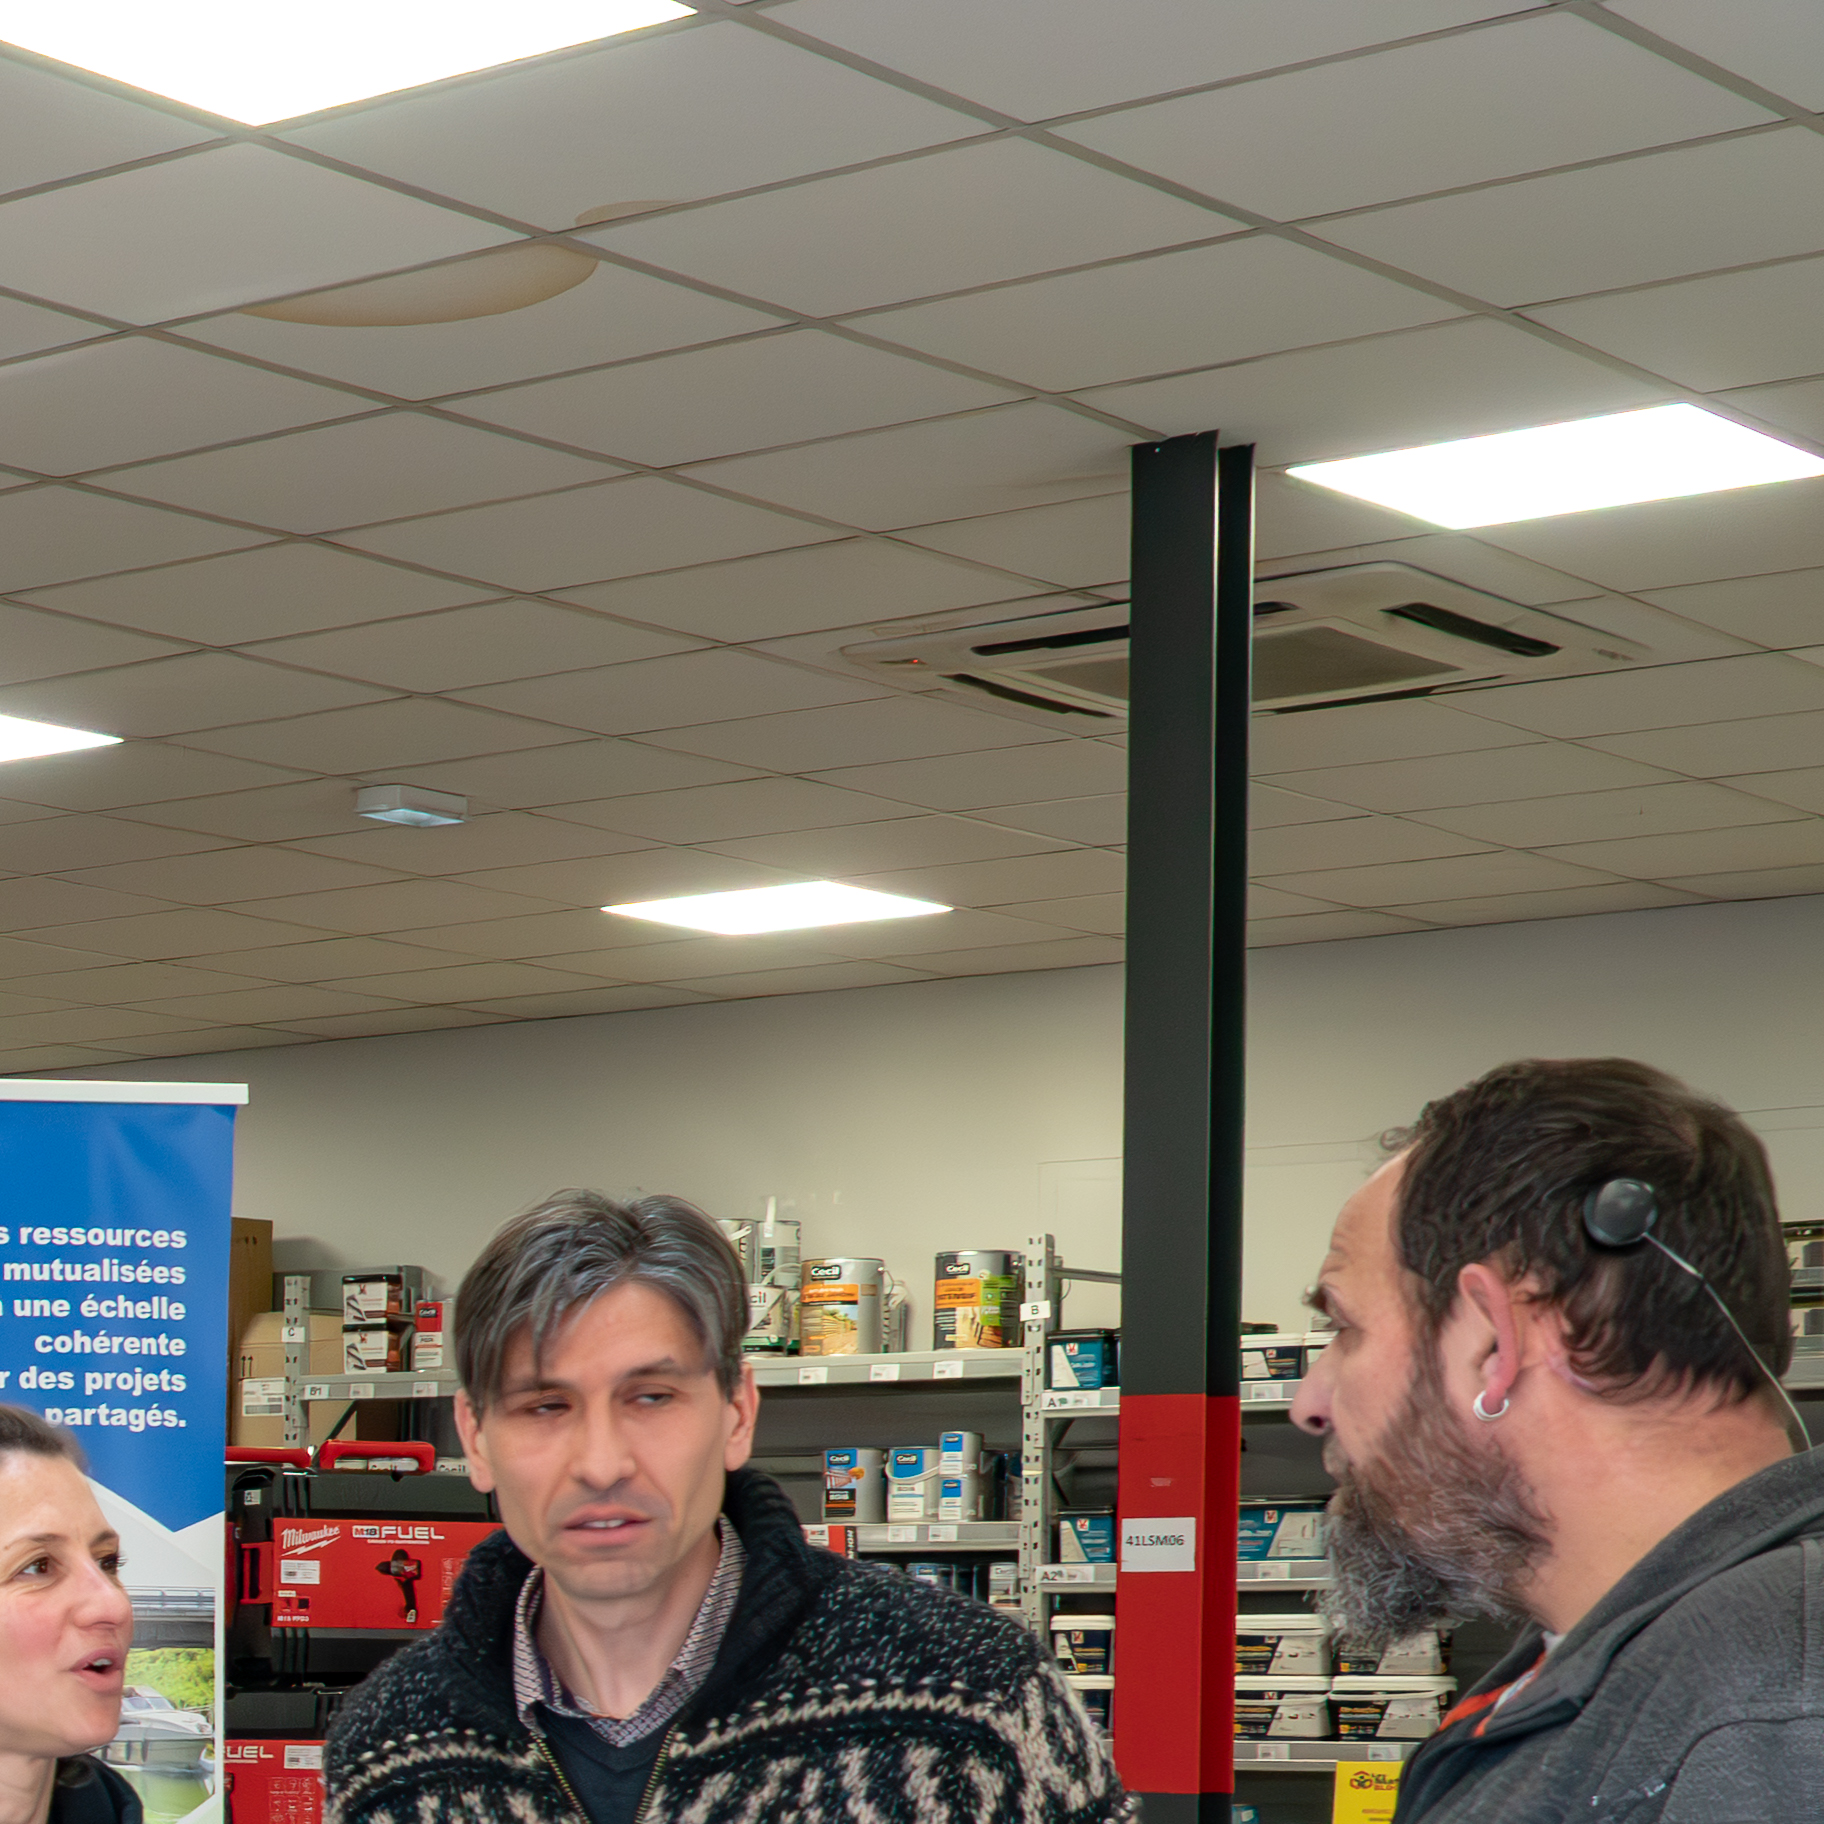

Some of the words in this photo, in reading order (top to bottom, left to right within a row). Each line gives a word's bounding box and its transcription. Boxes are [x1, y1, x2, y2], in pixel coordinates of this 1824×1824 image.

[19, 1225, 188, 1249] ressources
[3, 1258, 187, 1285] mutualisées
[811, 1265, 840, 1278] Cecil
[945, 1263, 970, 1275] Cecil
[13, 1298, 71, 1317] une
[80, 1293, 187, 1321] échelle
[1031, 1305, 1039, 1316] B
[287, 1328, 295, 1337] C
[34, 1330, 187, 1356] cohérente
[19, 1365, 75, 1390] des
[84, 1367, 187, 1397] projets
[44, 1403, 187, 1433] partagés.
[281, 1524, 341, 1549] Milwaukee
[380, 1525, 445, 1540] FUEL
[1125, 1534, 1185, 1547] 41LSM06
[225, 1746, 274, 1759] UEL
